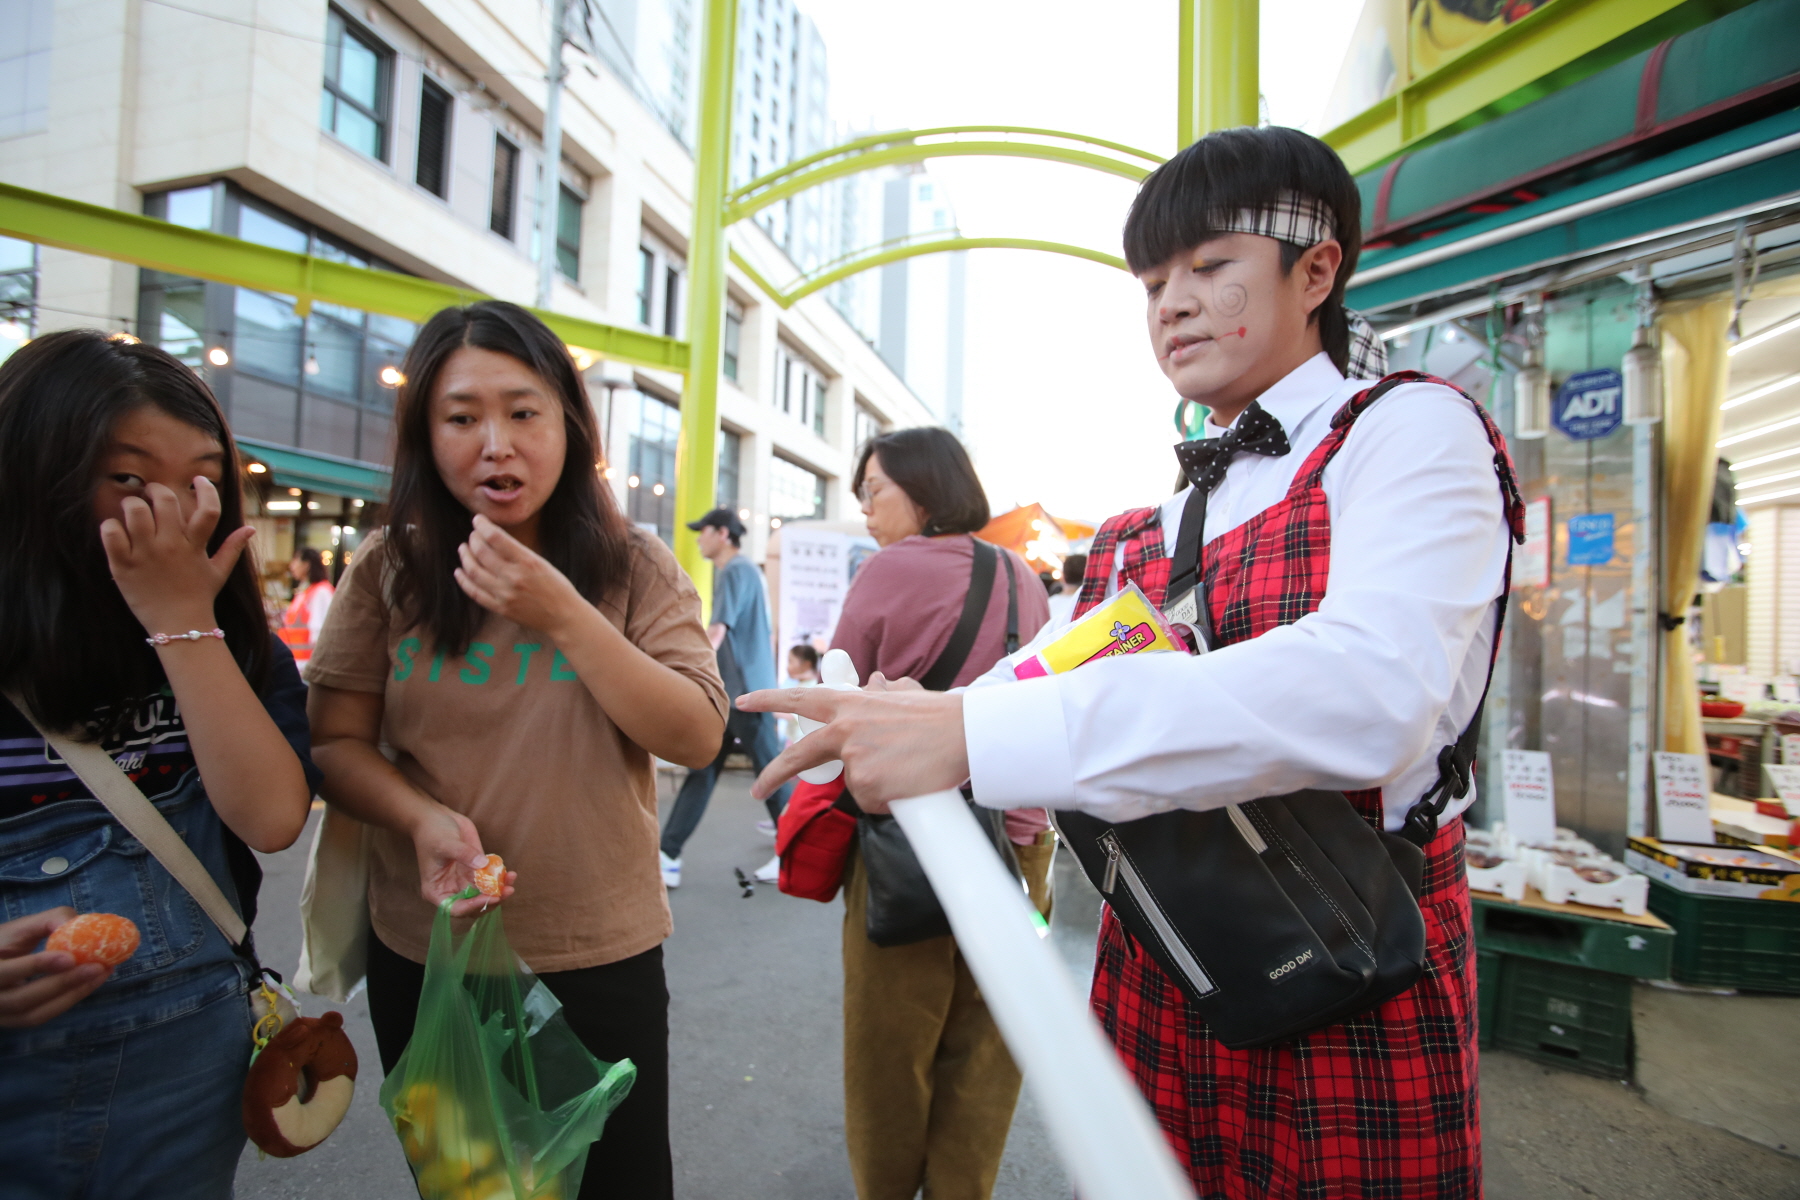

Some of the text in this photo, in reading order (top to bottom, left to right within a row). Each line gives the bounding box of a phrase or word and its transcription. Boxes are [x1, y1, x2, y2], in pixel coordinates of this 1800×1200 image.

[1560, 386, 1621, 421] ADT
[1181, 603, 1196, 619] DAY
[1101, 632, 1146, 658] TAINER
[114, 750, 148, 773] ght
[1269, 949, 1313, 980] GOOD DAY
